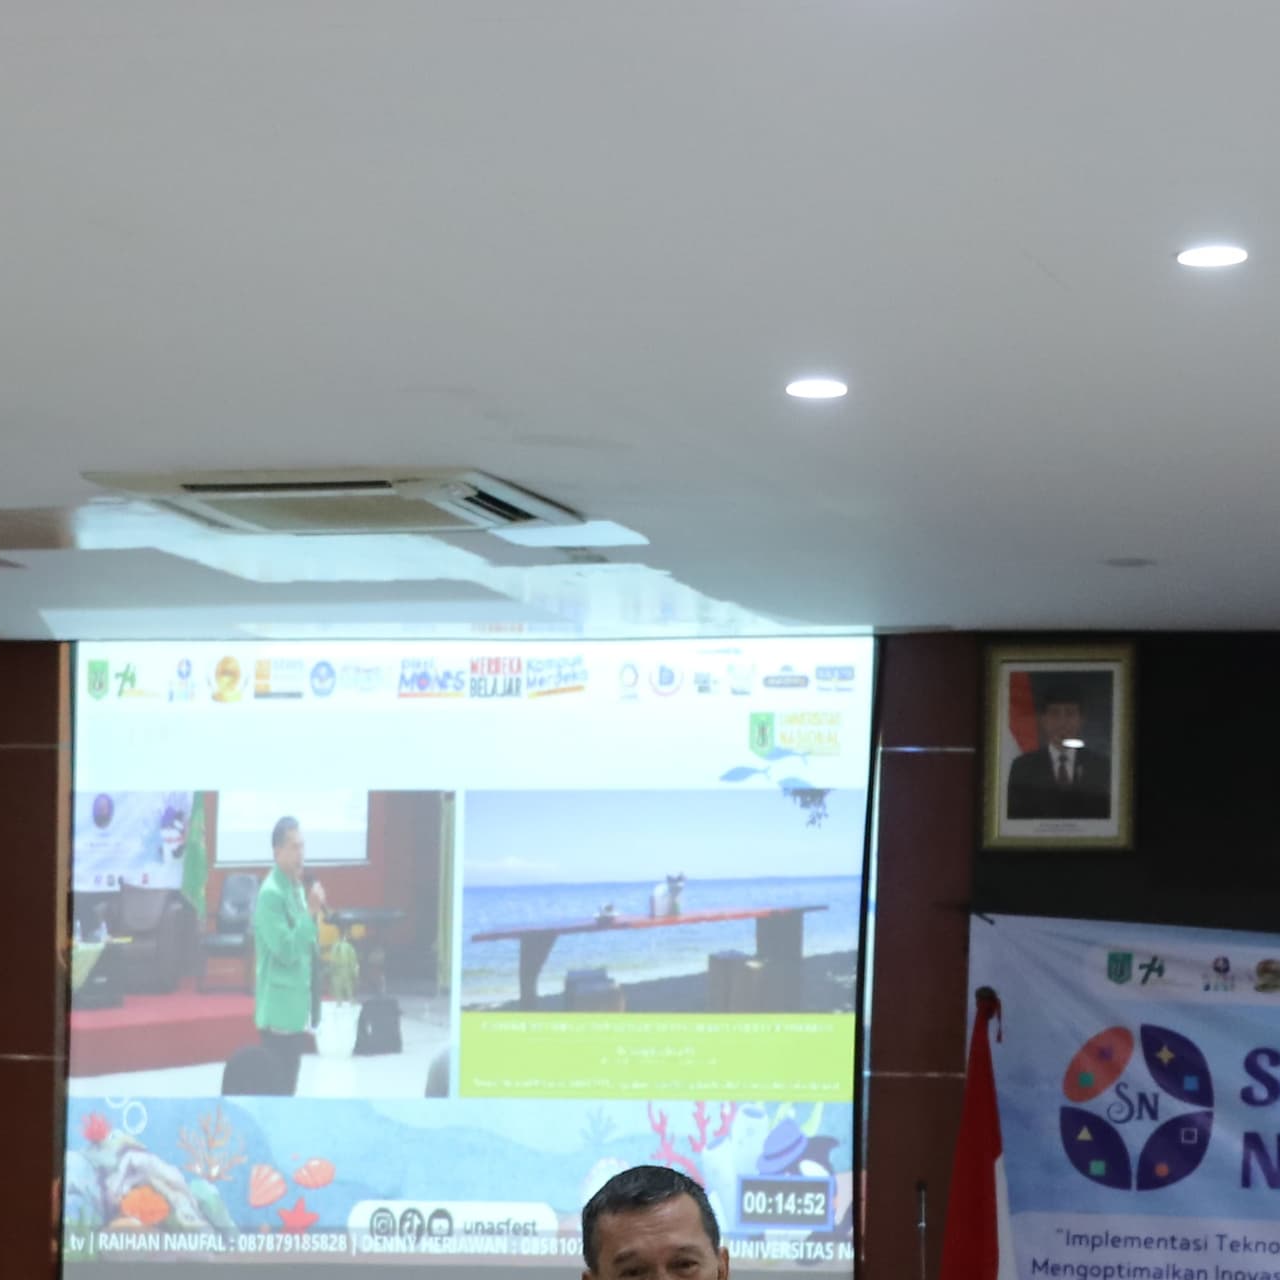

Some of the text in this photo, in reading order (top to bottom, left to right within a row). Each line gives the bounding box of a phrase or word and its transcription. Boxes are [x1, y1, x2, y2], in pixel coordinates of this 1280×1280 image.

[469, 677, 522, 698] BELAJAR
[1107, 1081, 1160, 1124] SN
[743, 1190, 826, 1216] 00:14:52
[463, 1217, 539, 1237] unasfest
[98, 1232, 160, 1250] RAIHAN
[164, 1233, 226, 1251] NAUFAL
[362, 1236, 416, 1252] DENNY
[728, 1239, 835, 1261] UNIVERSITAS
